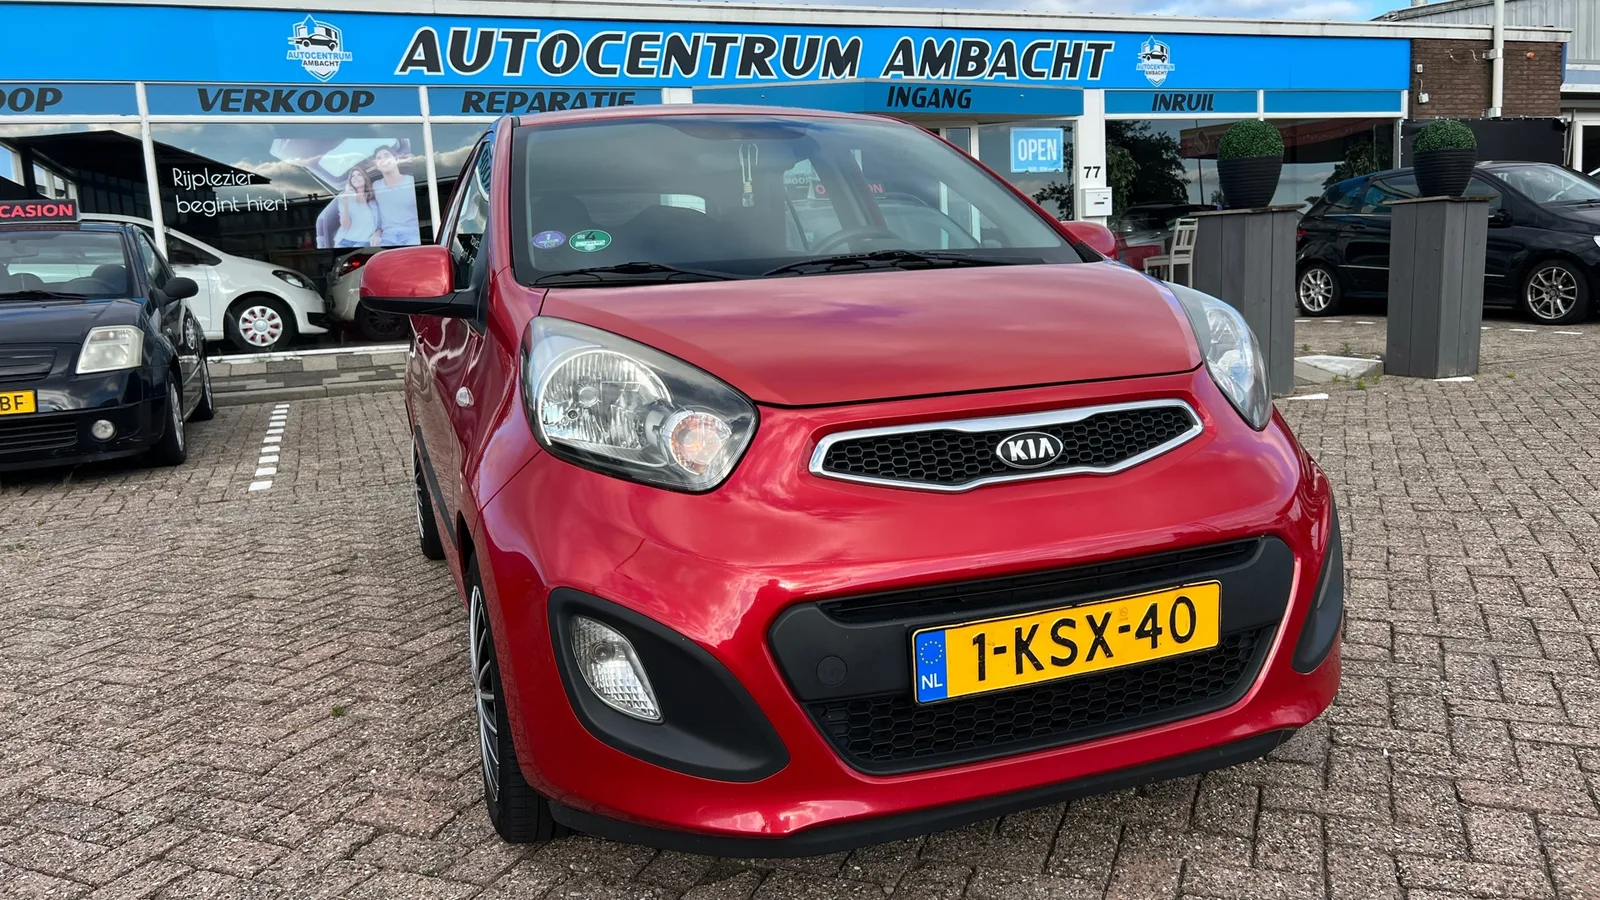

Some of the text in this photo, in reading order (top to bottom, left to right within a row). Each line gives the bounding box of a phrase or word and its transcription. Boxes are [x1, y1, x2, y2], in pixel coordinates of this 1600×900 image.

[287, 51, 352, 60] AUTOCENTRUM
[394, 26, 1115, 81] AUTOCENTRUM AMBACHT
[197, 88, 375, 114] VERKOOP
[461, 91, 636, 114] REPARATIE
[886, 85, 972, 109] INGANG
[1151, 93, 1214, 112] INRUIL
[1017, 138, 1058, 162] OPEN
[172, 167, 255, 191] Rijplezier
[1083, 166, 1101, 179] 77
[175, 193, 288, 217] begint hier!
[1007, 437, 1056, 462] KIA
[971, 595, 1198, 682] 1-KSX-40
[921, 673, 943, 690] NL
